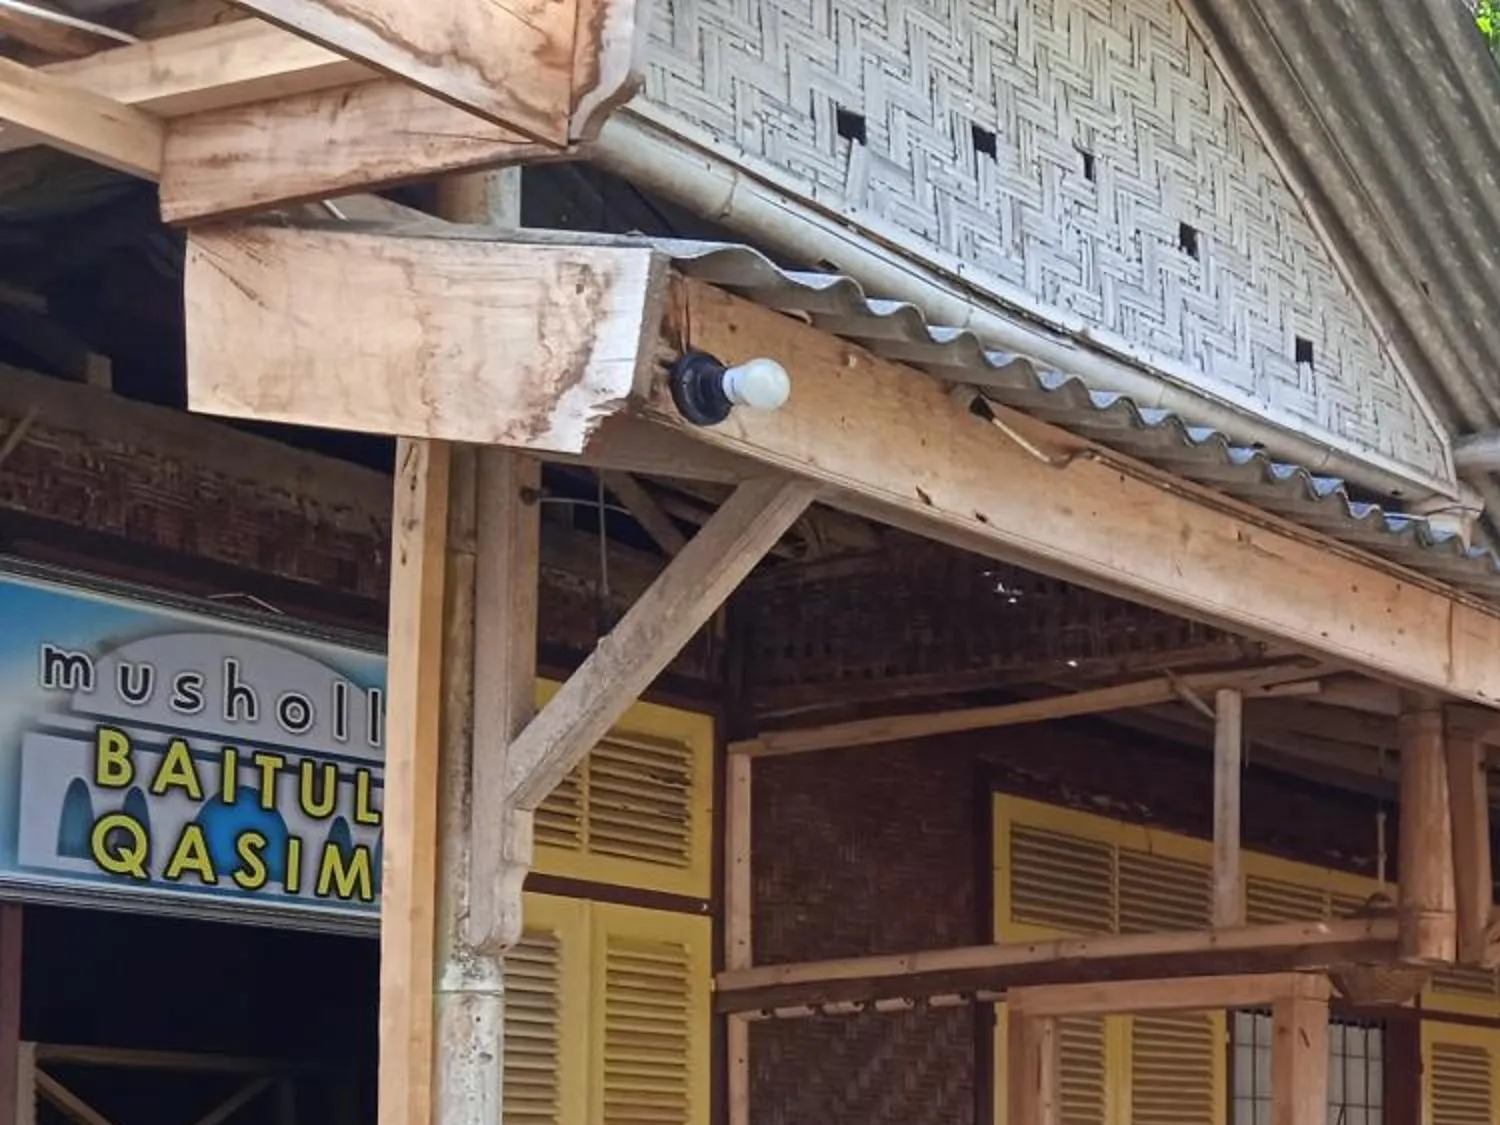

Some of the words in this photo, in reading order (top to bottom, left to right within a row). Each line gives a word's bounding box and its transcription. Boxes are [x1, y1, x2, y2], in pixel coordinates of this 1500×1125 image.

[40, 643, 382, 746] musholl
[94, 725, 382, 825] BAITUL
[90, 812, 375, 901] QASIM
